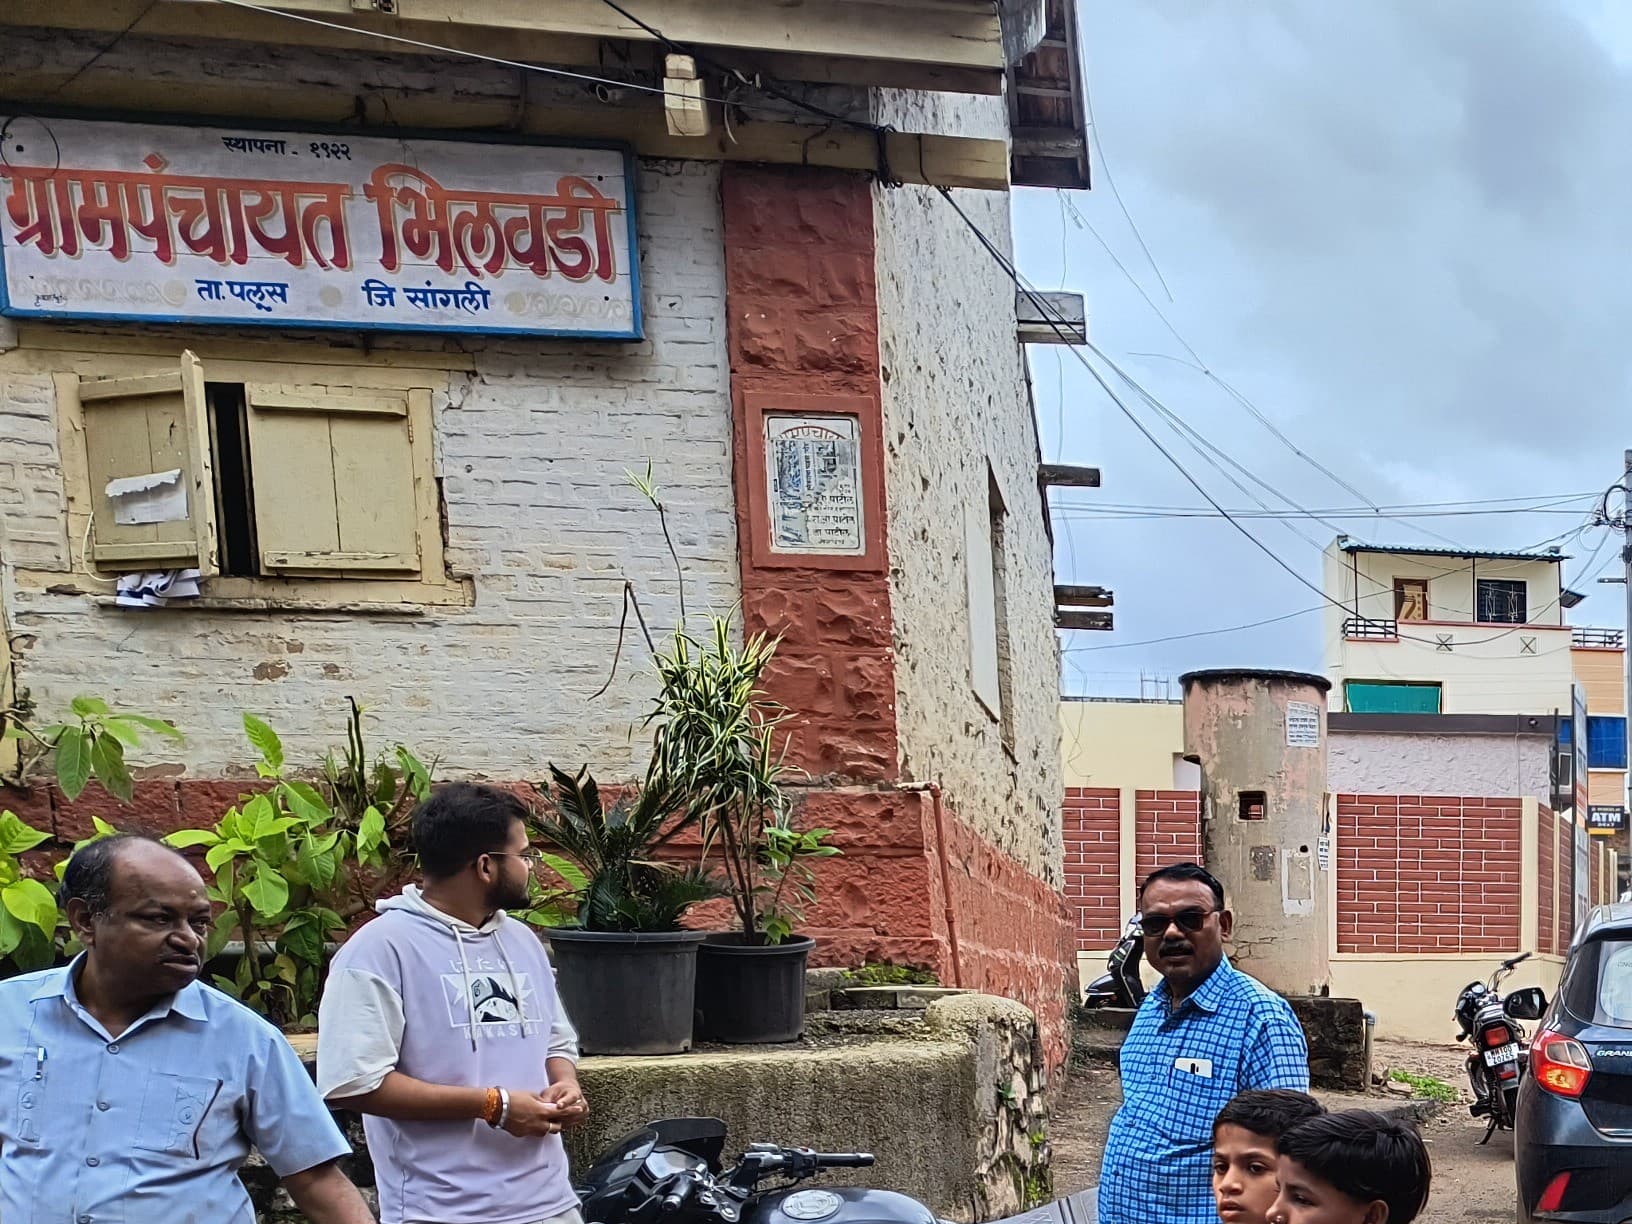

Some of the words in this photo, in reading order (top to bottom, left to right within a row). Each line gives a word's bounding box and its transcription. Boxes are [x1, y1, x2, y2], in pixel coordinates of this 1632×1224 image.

[221, 136, 287, 155] स्थापना
[0, 151, 351, 272] ग्रामपंचायत
[363, 161, 623, 282] भिलवडी
[361, 278, 396, 308] जि
[403, 279, 491, 315] सांगली
[1591, 812, 1621, 823] ATM
